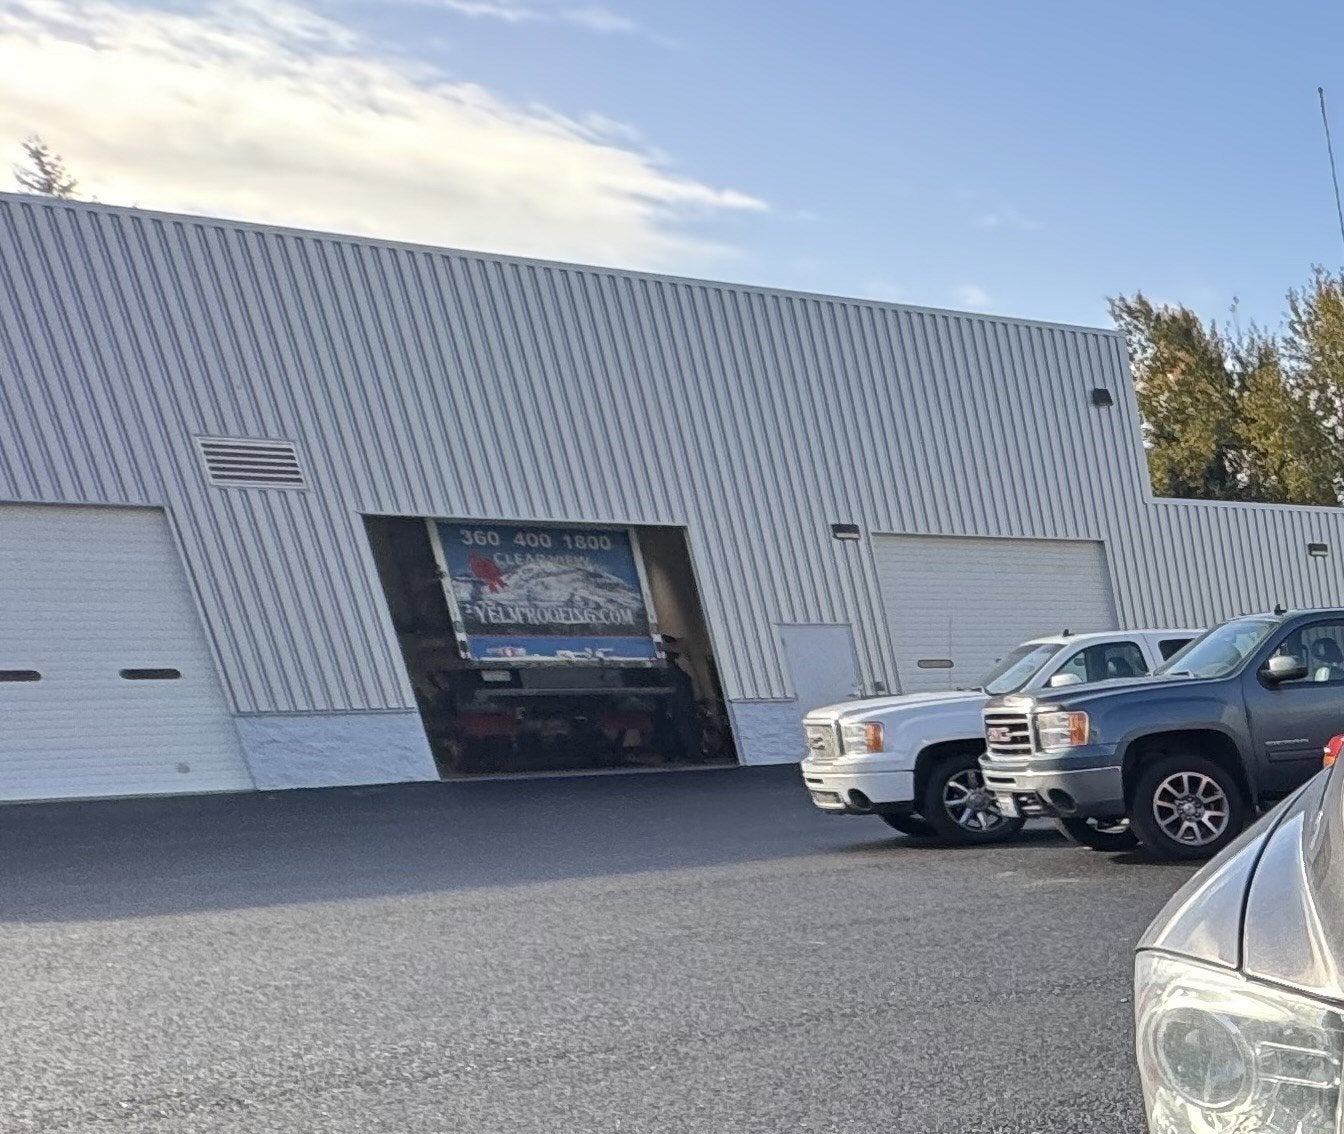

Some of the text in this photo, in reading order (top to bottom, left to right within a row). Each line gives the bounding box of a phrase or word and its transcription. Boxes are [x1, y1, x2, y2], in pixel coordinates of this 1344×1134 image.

[460, 529, 612, 551] 360 400 1800
